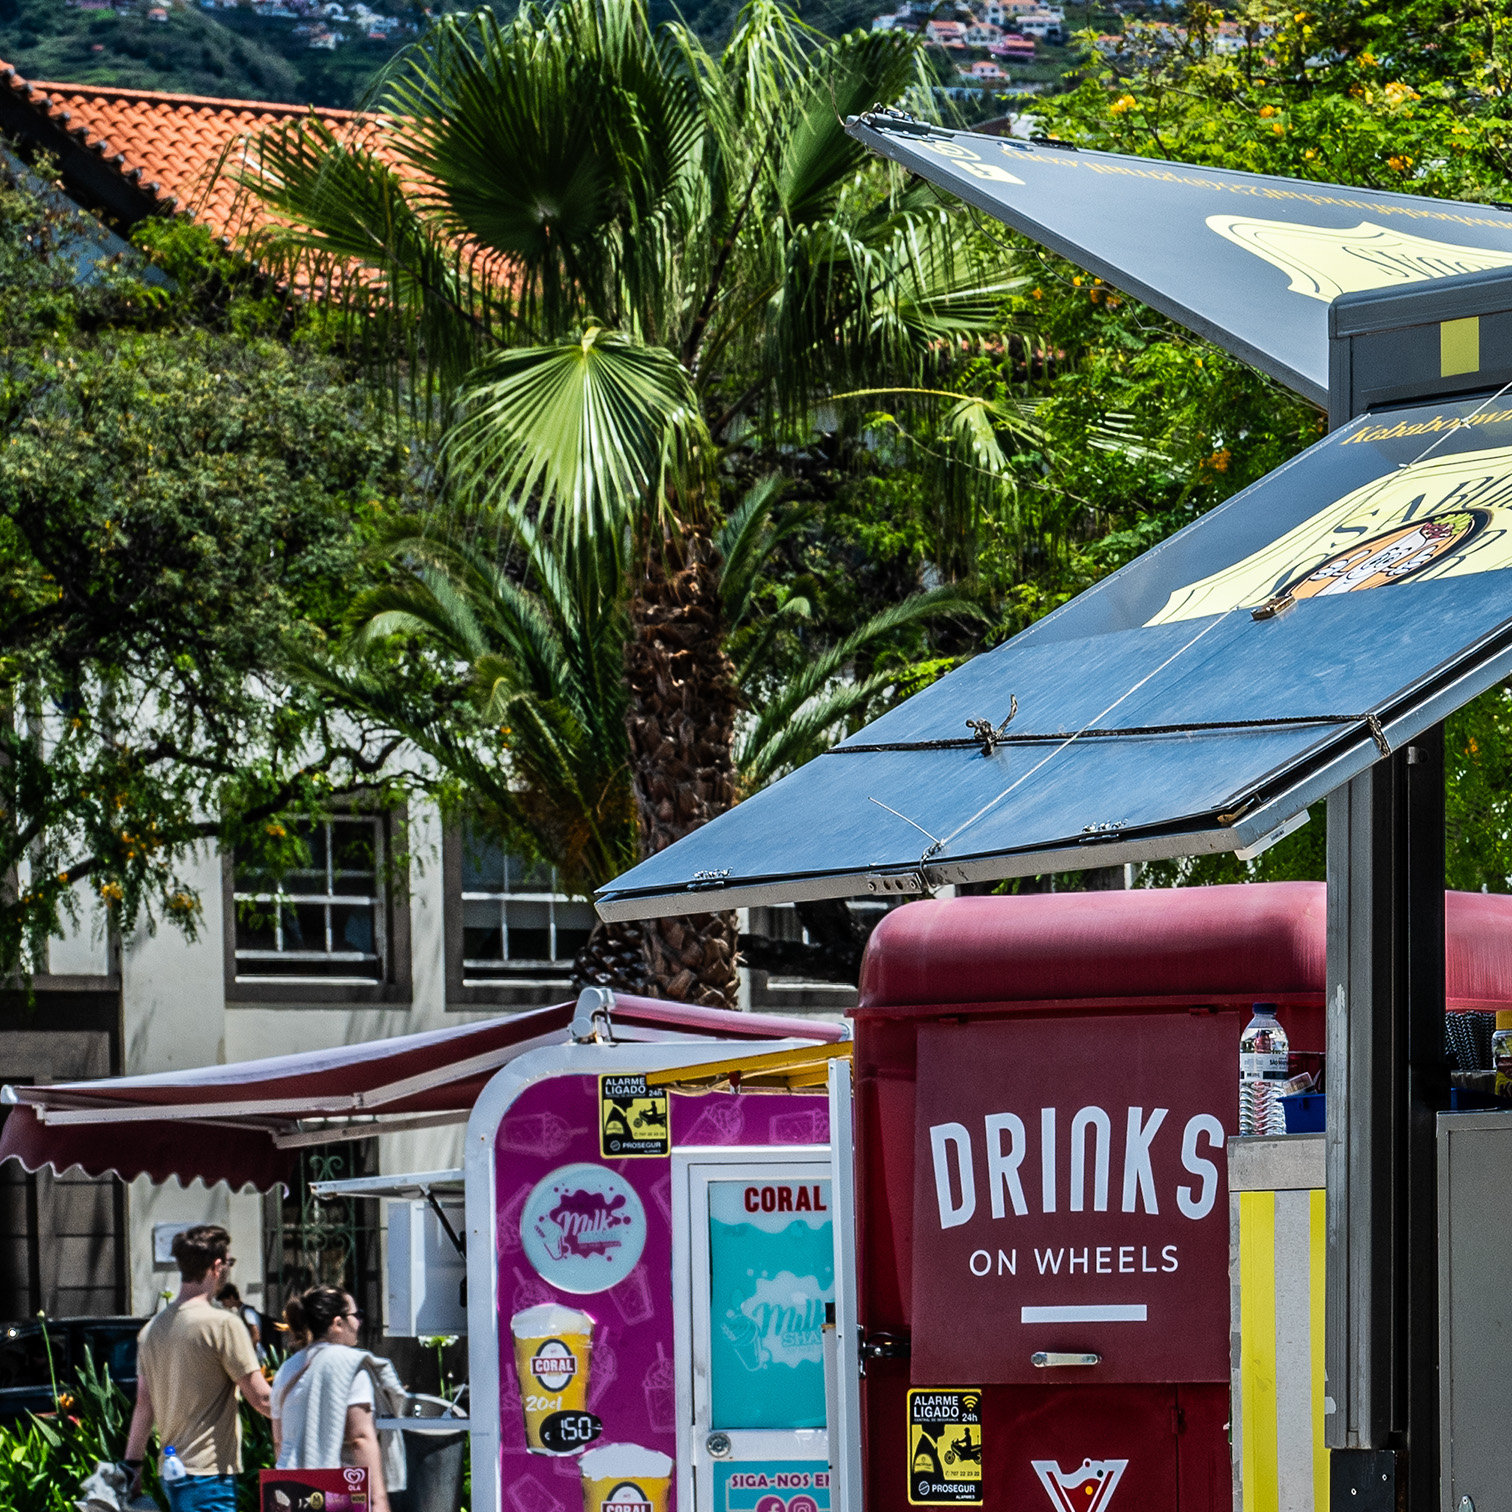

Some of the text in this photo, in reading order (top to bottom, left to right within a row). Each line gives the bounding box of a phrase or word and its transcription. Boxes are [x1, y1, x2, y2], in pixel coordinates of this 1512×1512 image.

[605, 1077, 645, 1086] ALARME
[605, 1086, 646, 1095] LIGADO
[622, 1141, 661, 1149] PROSEGUR
[928, 1105, 1226, 1230] DRINKS
[744, 1185, 827, 1212] CORAL
[969, 1244, 1179, 1277] ON WHEELS
[535, 1359, 574, 1372] CORAL
[525, 1395, 562, 1412] 20cl
[914, 1396, 959, 1405] ALARME
[914, 1406, 978, 1422] LIGADO 24h
[732, 1474, 809, 1488] SIGA-NOS
[932, 1484, 976, 1493] PROSEGUR
